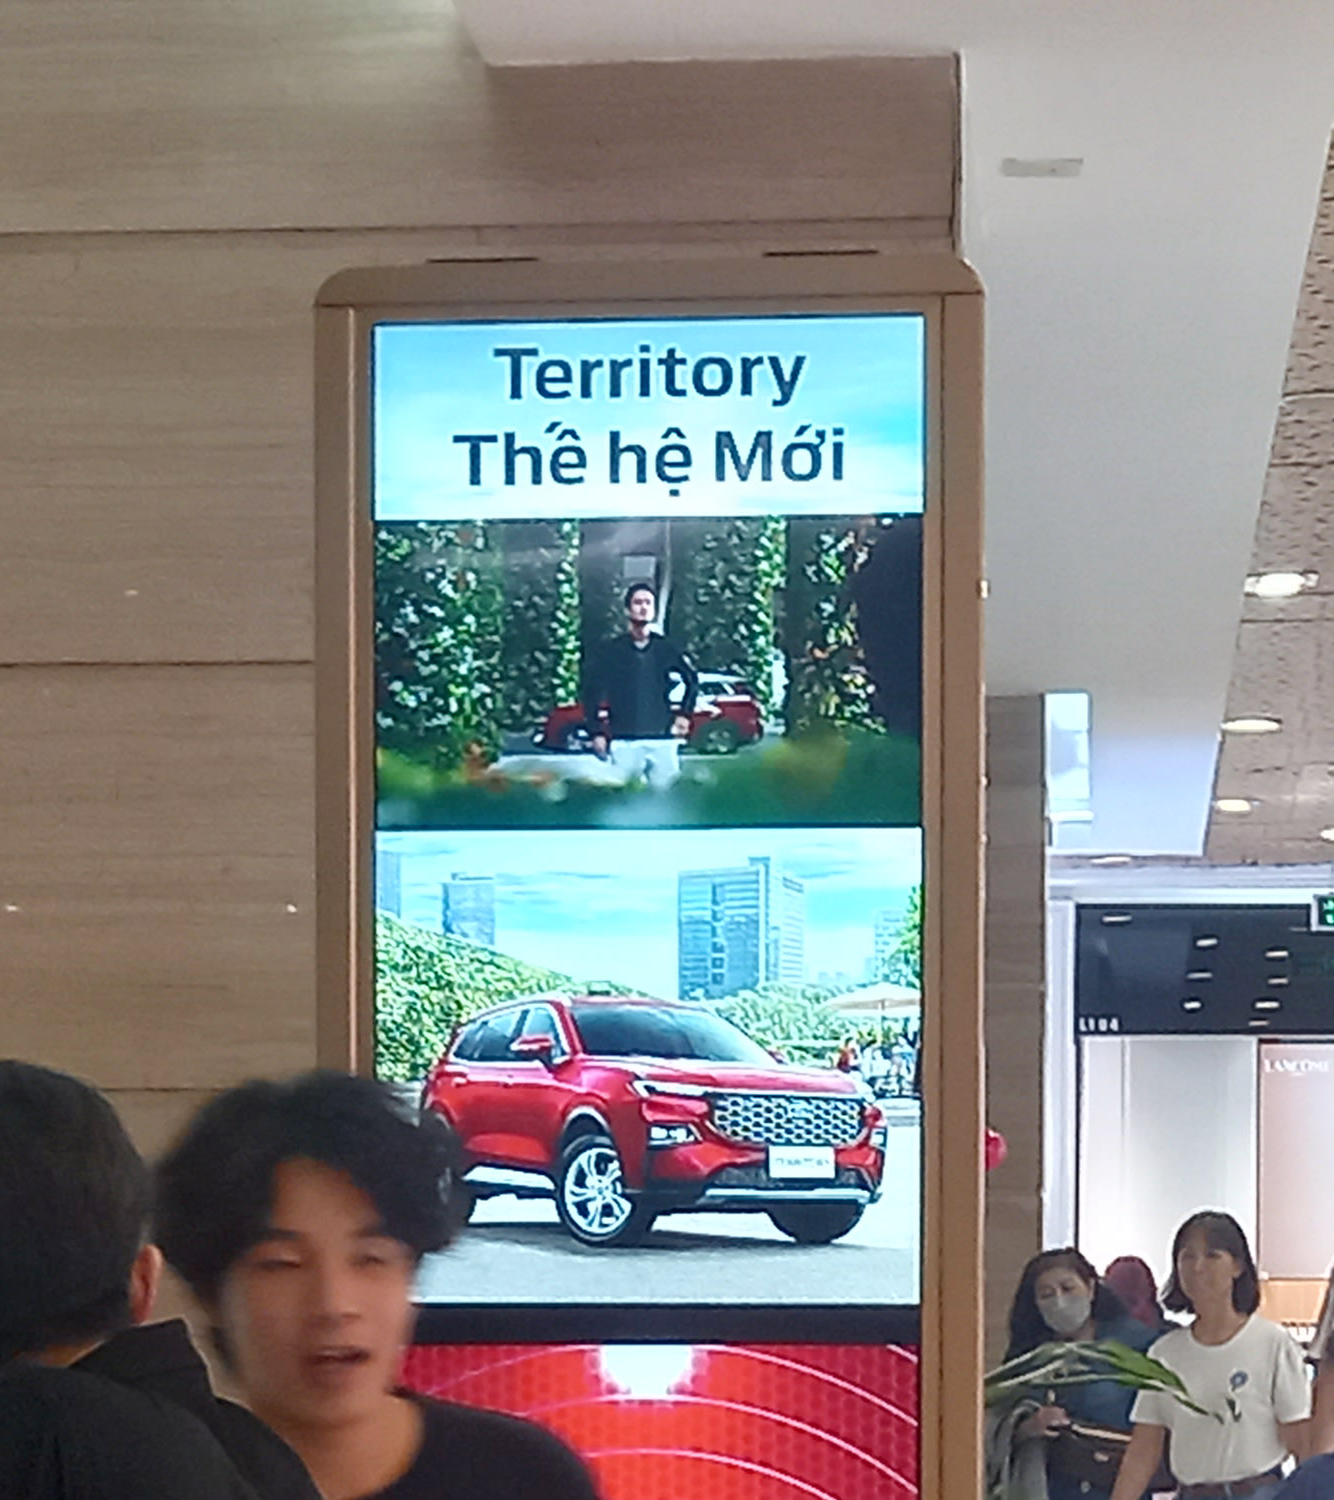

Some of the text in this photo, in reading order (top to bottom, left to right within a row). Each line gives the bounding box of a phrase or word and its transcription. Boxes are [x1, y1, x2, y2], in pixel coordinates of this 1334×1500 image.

[493, 344, 806, 406] Territory
[453, 421, 844, 497] Thế hệ Mới
